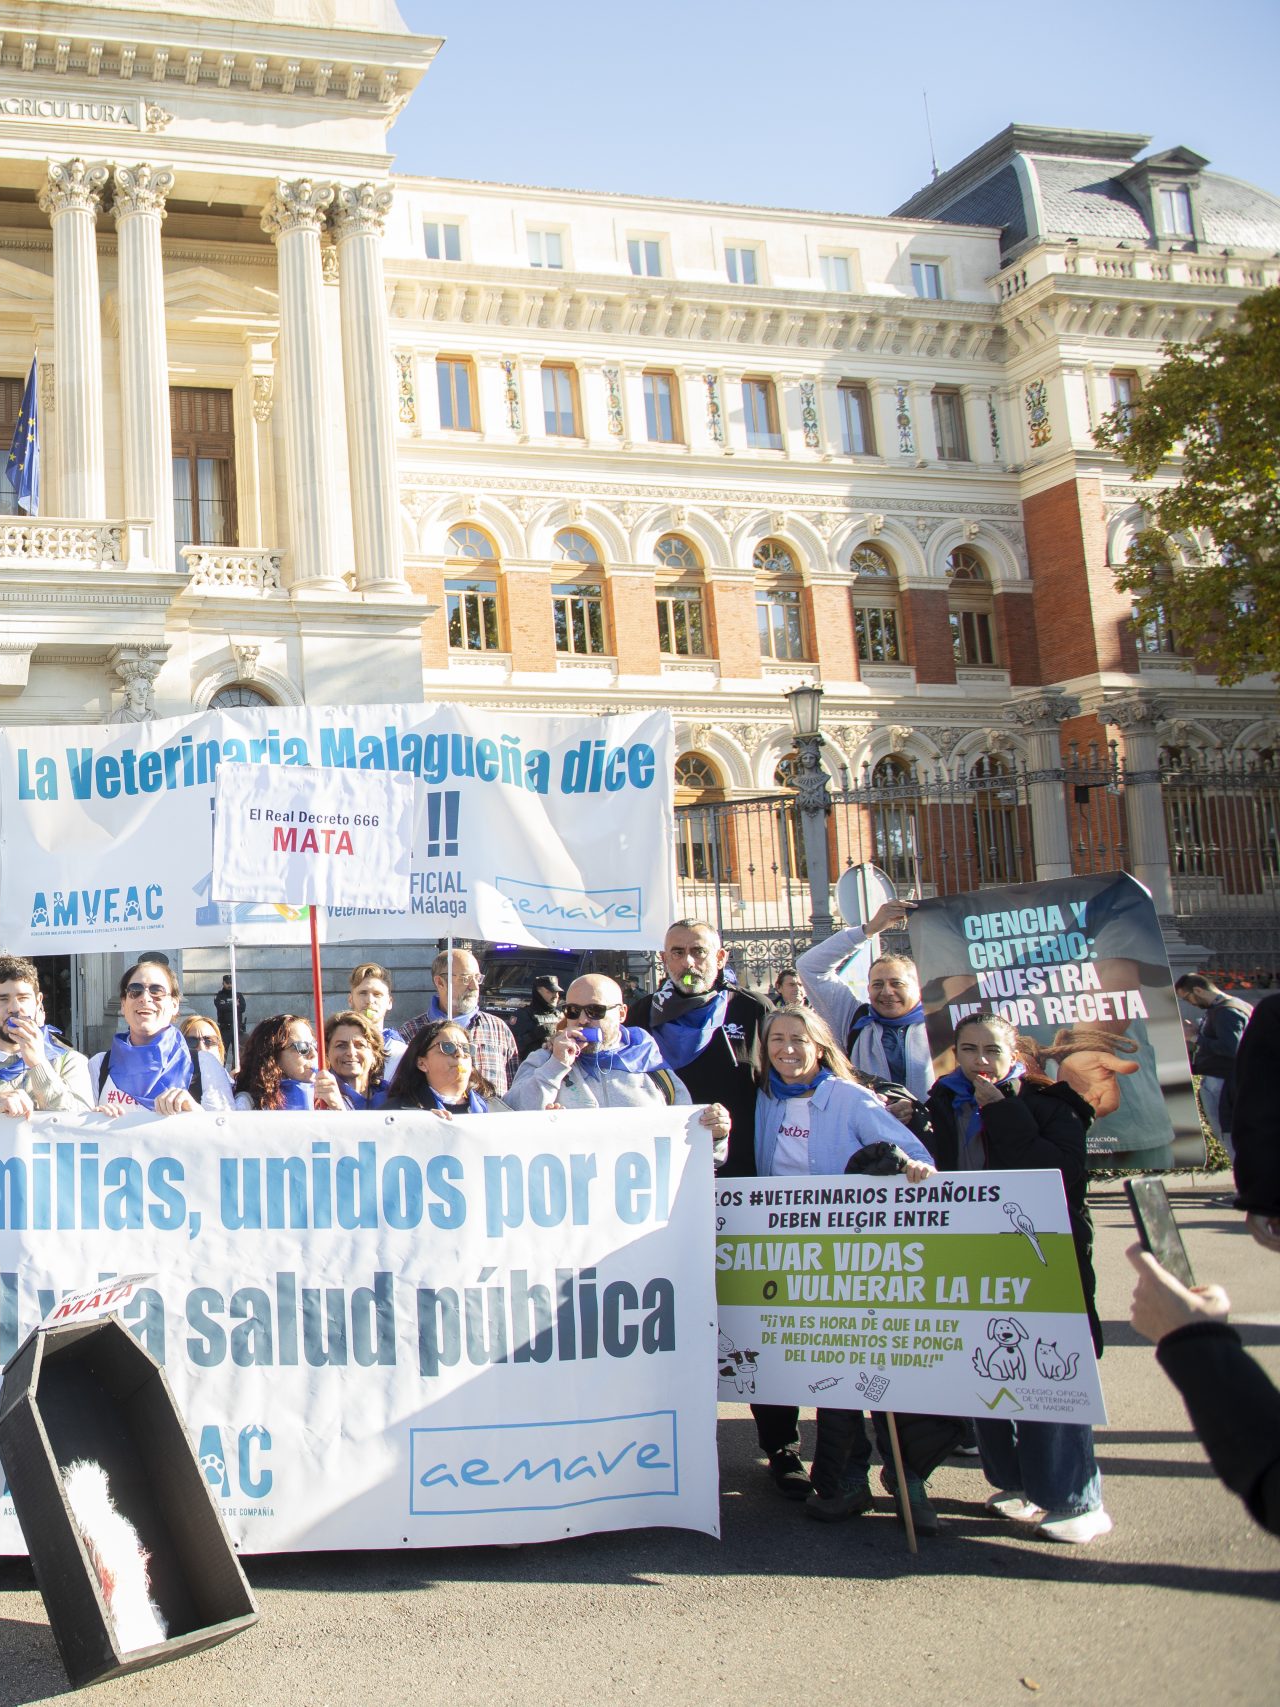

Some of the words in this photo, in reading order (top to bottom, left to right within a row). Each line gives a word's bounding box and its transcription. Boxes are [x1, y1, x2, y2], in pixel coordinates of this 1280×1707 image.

[18, 747, 58, 801] La
[320, 726, 550, 794] Malagueña
[560, 739, 656, 794] dice
[249, 808, 261, 821] El
[265, 809, 294, 822] Real
[299, 811, 349, 826] Decreto
[354, 814, 379, 827] 666
[273, 827, 354, 856] MATA
[410, 871, 467, 894] FICIAL
[31, 883, 163, 927] AMVEAC
[411, 895, 467, 918] Málaga
[964, 904, 1066, 941] CIENCIA
[1070, 901, 1088, 928] Y
[968, 932, 1098, 970] CRITERIO:
[976, 962, 1102, 999] NUESTRA
[1044, 989, 1149, 1025] RECETA
[220, 1140, 470, 1230] unidos
[483, 1152, 598, 1238] por
[613, 1136, 671, 1224] el
[749, 1187, 888, 1207] #VETERINARIOS
[894, 1181, 1001, 1204] ESPAÑOLES
[769, 1211, 821, 1229] DEBEN
[827, 1210, 887, 1229] ELEGIR
[893, 1210, 950, 1228] ENTRE
[715, 1241, 823, 1272] SALVAR
[832, 1242, 926, 1273] VIDAS
[53, 1283, 133, 1320] MATA
[786, 1274, 926, 1302] VULNERAR
[935, 1275, 970, 1304] LA
[979, 1276, 1032, 1305] LEY
[186, 1271, 397, 1368] salud
[419, 1266, 676, 1377] pública
[799, 1316, 816, 1329] ES
[819, 1316, 857, 1330] HORA
[861, 1317, 878, 1331] DE
[882, 1317, 911, 1332] QUE
[915, 1318, 931, 1332] LA
[935, 1319, 960, 1333] LEY
[761, 1331, 777, 1345] DE
[781, 1332, 888, 1349] MEDICAMENTOS
[892, 1335, 909, 1349] SE
[913, 1336, 963, 1351] PONGA
[784, 1349, 806, 1362] DEL
[811, 1350, 845, 1363] LADO
[849, 1351, 866, 1365] DE
[870, 1352, 886, 1366] LA
[1015, 1388, 1053, 1396] COLEGIO
[1056, 1390, 1088, 1398] OFICIAL
[1035, 1396, 1091, 1406] VETERINARIOS
[1042, 1405, 1074, 1413] MADRID
[419, 1437, 672, 1489] aemave
[239, 1506, 275, 1517] COMPAÑÍA
